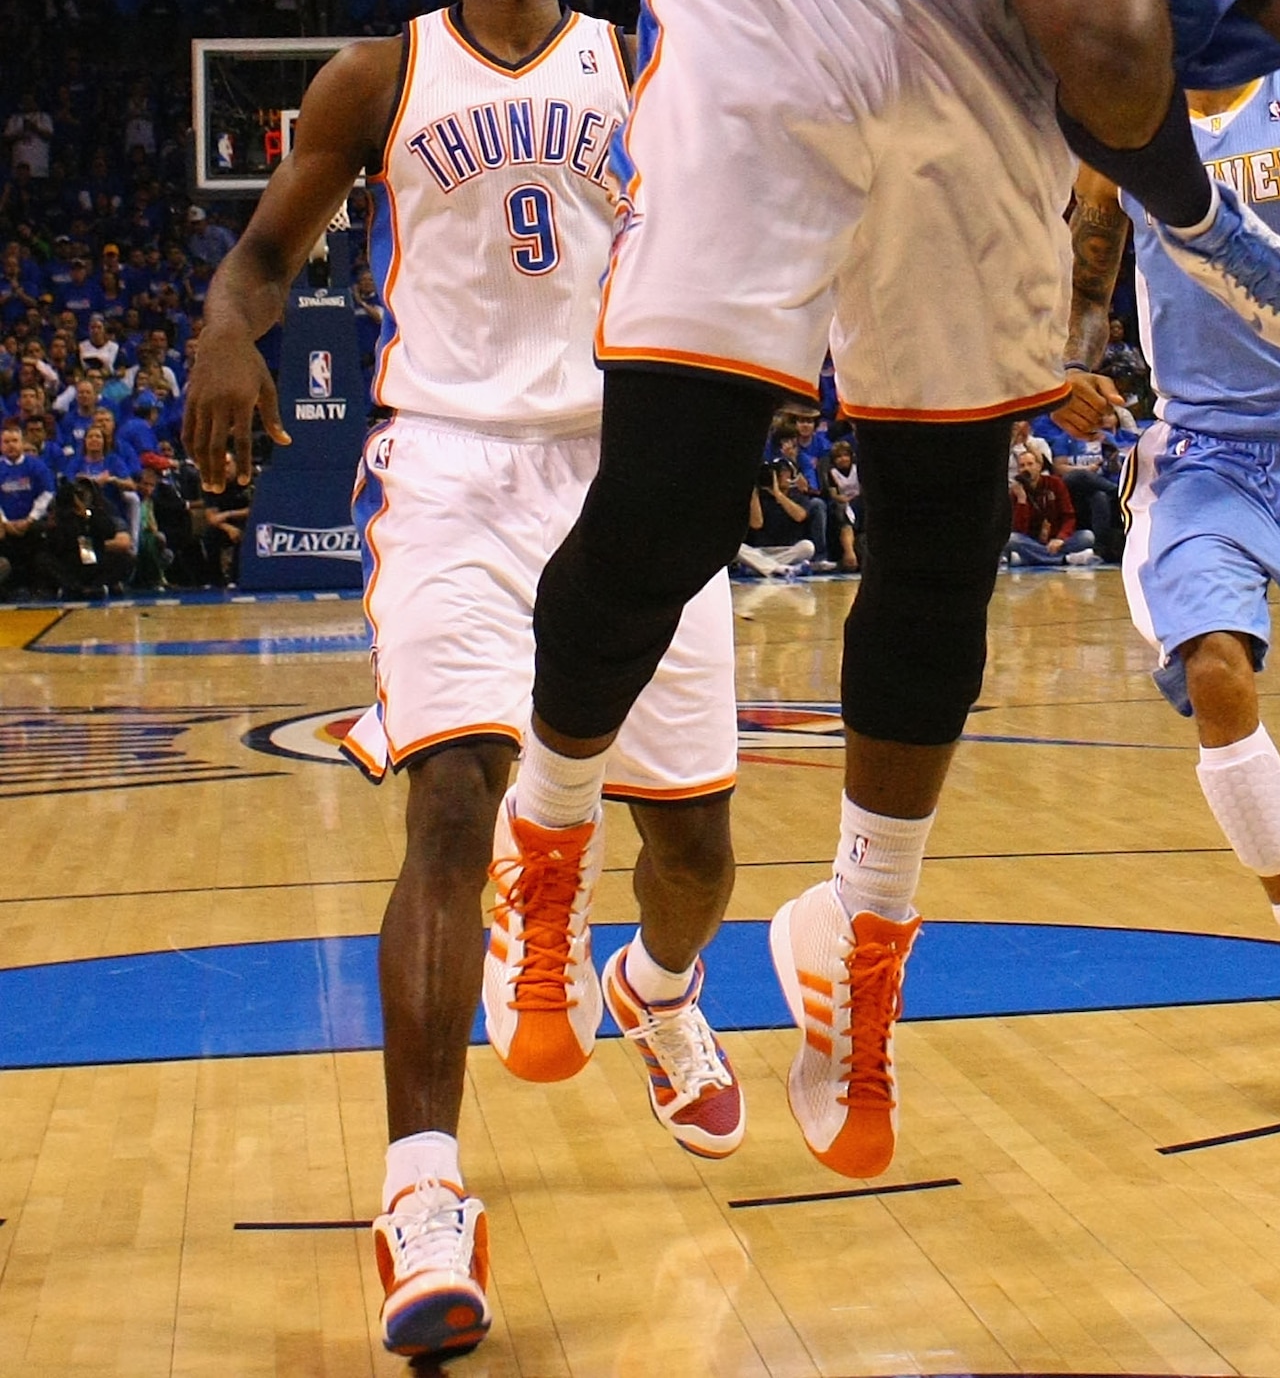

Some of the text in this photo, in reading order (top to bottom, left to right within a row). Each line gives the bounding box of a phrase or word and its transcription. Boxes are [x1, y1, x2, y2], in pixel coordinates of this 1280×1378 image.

[504, 183, 560, 276] 9
[298, 295, 345, 308] SPALDING
[296, 403, 347, 420] NBA TV
